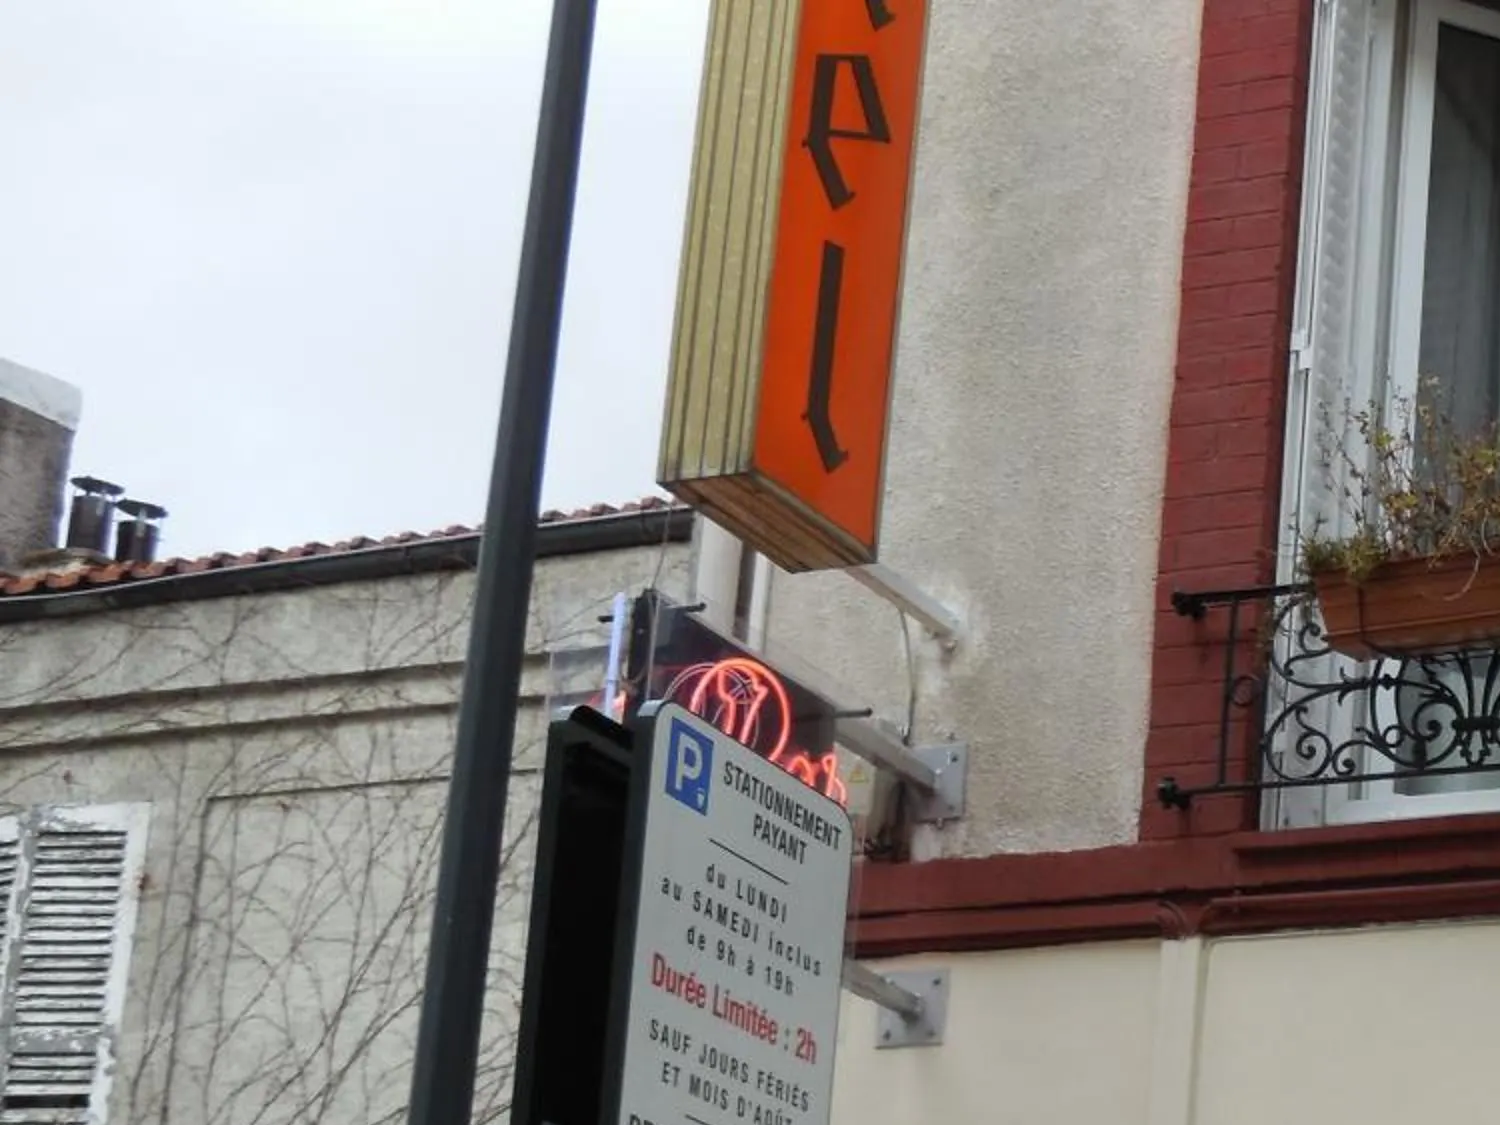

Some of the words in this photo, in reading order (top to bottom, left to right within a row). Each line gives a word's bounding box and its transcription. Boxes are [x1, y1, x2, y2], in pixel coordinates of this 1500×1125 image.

[801, 0, 896, 474] el
[675, 735, 703, 791] P
[724, 761, 842, 850] STATIONNEMENT
[753, 815, 807, 864] PAYANT
[661, 877, 682, 901] au
[693, 890, 759, 943] SAMEDI
[768, 931, 820, 976] inclus
[706, 863, 726, 889] du
[736, 879, 787, 923] LUNDI
[687, 926, 706, 951] de
[716, 940, 736, 967] 9h
[765, 965, 794, 995] 19h
[652, 951, 706, 1009] Durée
[712, 983, 778, 1045] Limitée
[795, 1027, 817, 1065] 2h
[649, 1019, 691, 1054] SAUF
[699, 1044, 748, 1083] JOURS
[757, 1070, 808, 1112] FÉRIÉS
[661, 1062, 680, 1087] ET
[689, 1074, 728, 1110] MOIS
